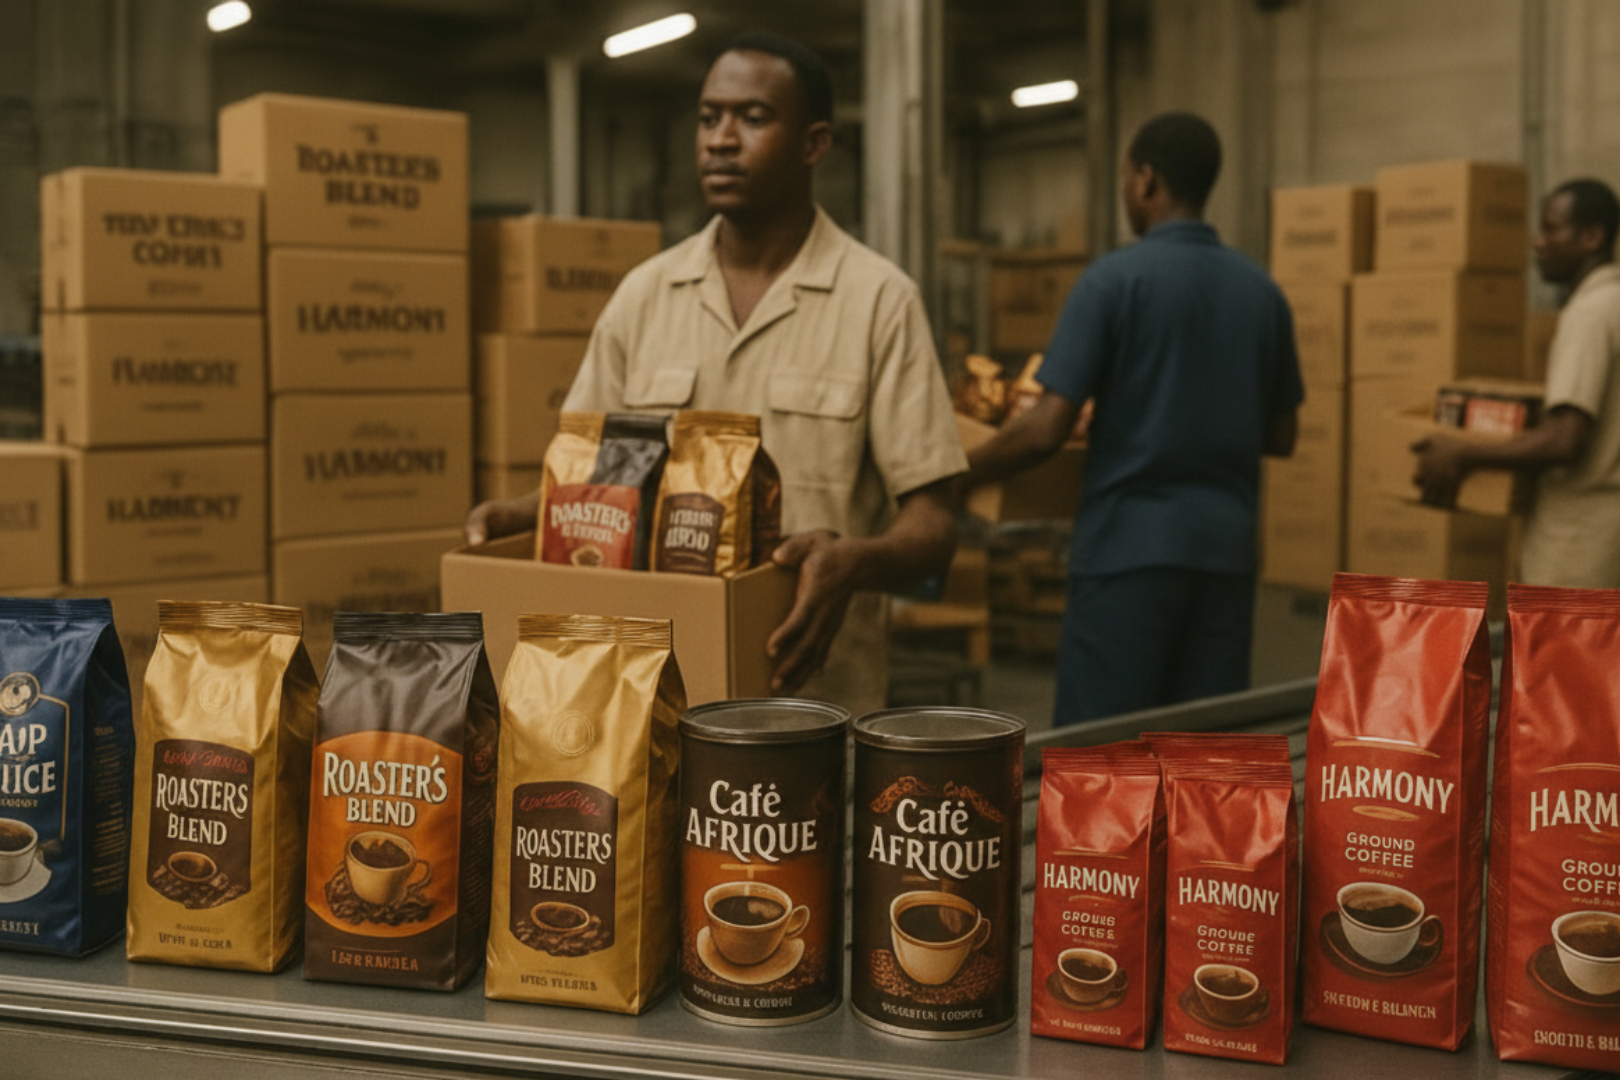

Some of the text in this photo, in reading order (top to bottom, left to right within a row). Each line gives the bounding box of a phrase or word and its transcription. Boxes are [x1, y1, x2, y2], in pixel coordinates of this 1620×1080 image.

[156, 773, 249, 819] ROASTERS
[1321, 764, 1454, 814] HARMONY
[167, 812, 227, 845] BLEND
[346, 797, 416, 828] BLEND
[516, 825, 612, 865] ROASTERS
[686, 807, 817, 862] AFRIQUE
[868, 825, 1000, 880] AFRIQUE
[1346, 832, 1415, 851] GROUND
[1344, 847, 1414, 868] COFFEE
[528, 862, 597, 894] BLEND
[1043, 863, 1140, 899] HARMONY
[1179, 876, 1280, 917] HARMONY
